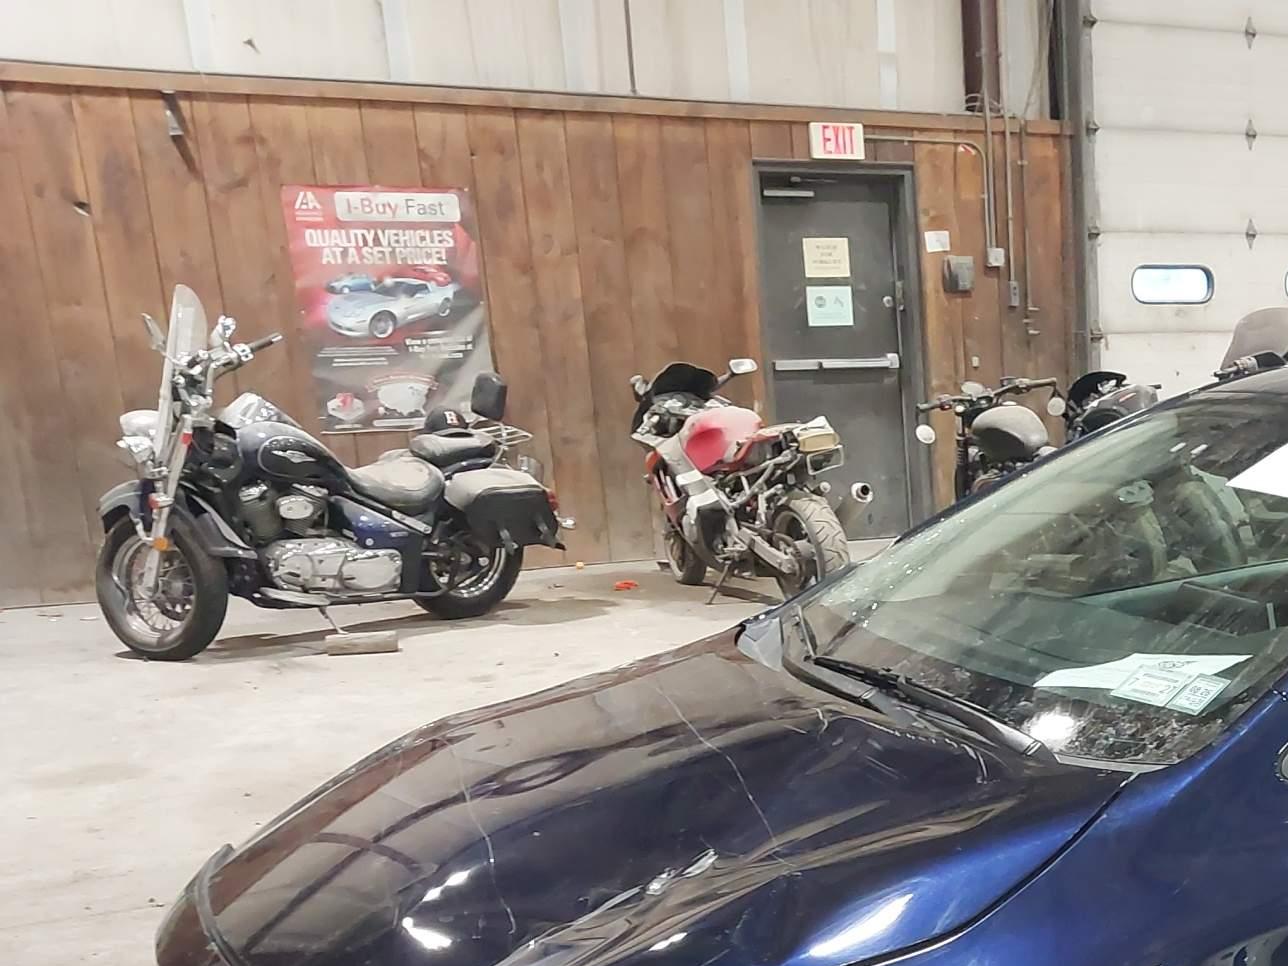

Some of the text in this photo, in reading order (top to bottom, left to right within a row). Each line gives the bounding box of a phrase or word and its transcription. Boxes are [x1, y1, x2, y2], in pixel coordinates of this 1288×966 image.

[821, 124, 856, 155] EXIT
[346, 198, 446, 218] I-Buy Fast
[305, 229, 455, 248] QUALITY VEHICLES
[322, 247, 448, 265] AT A SET PRICE!
